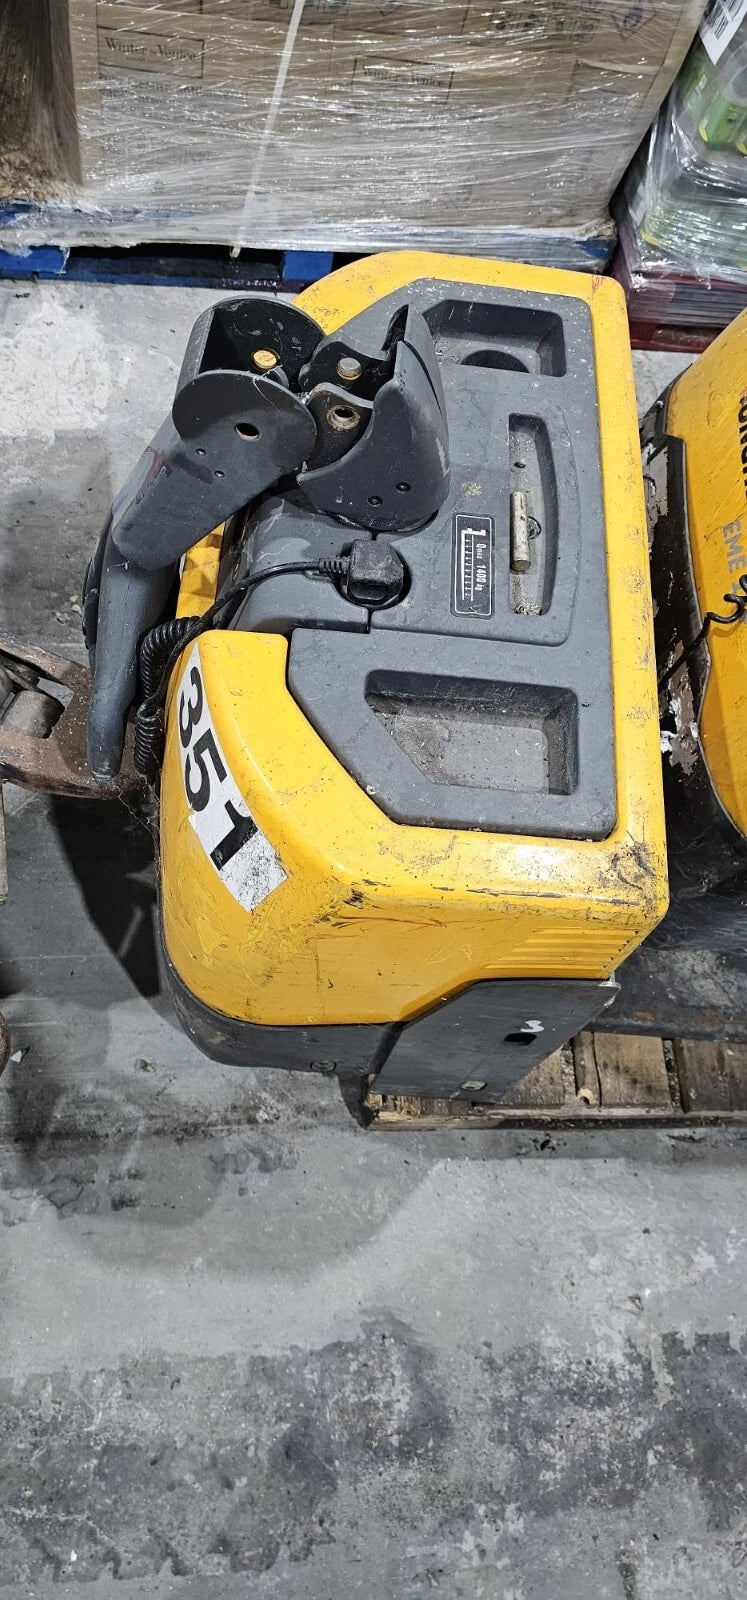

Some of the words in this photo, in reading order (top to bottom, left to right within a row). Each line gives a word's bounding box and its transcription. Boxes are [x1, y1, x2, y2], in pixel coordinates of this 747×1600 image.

[105, 37, 147, 55] Winter
[722, 520, 746, 574] EME
[179, 667, 259, 871] 351
